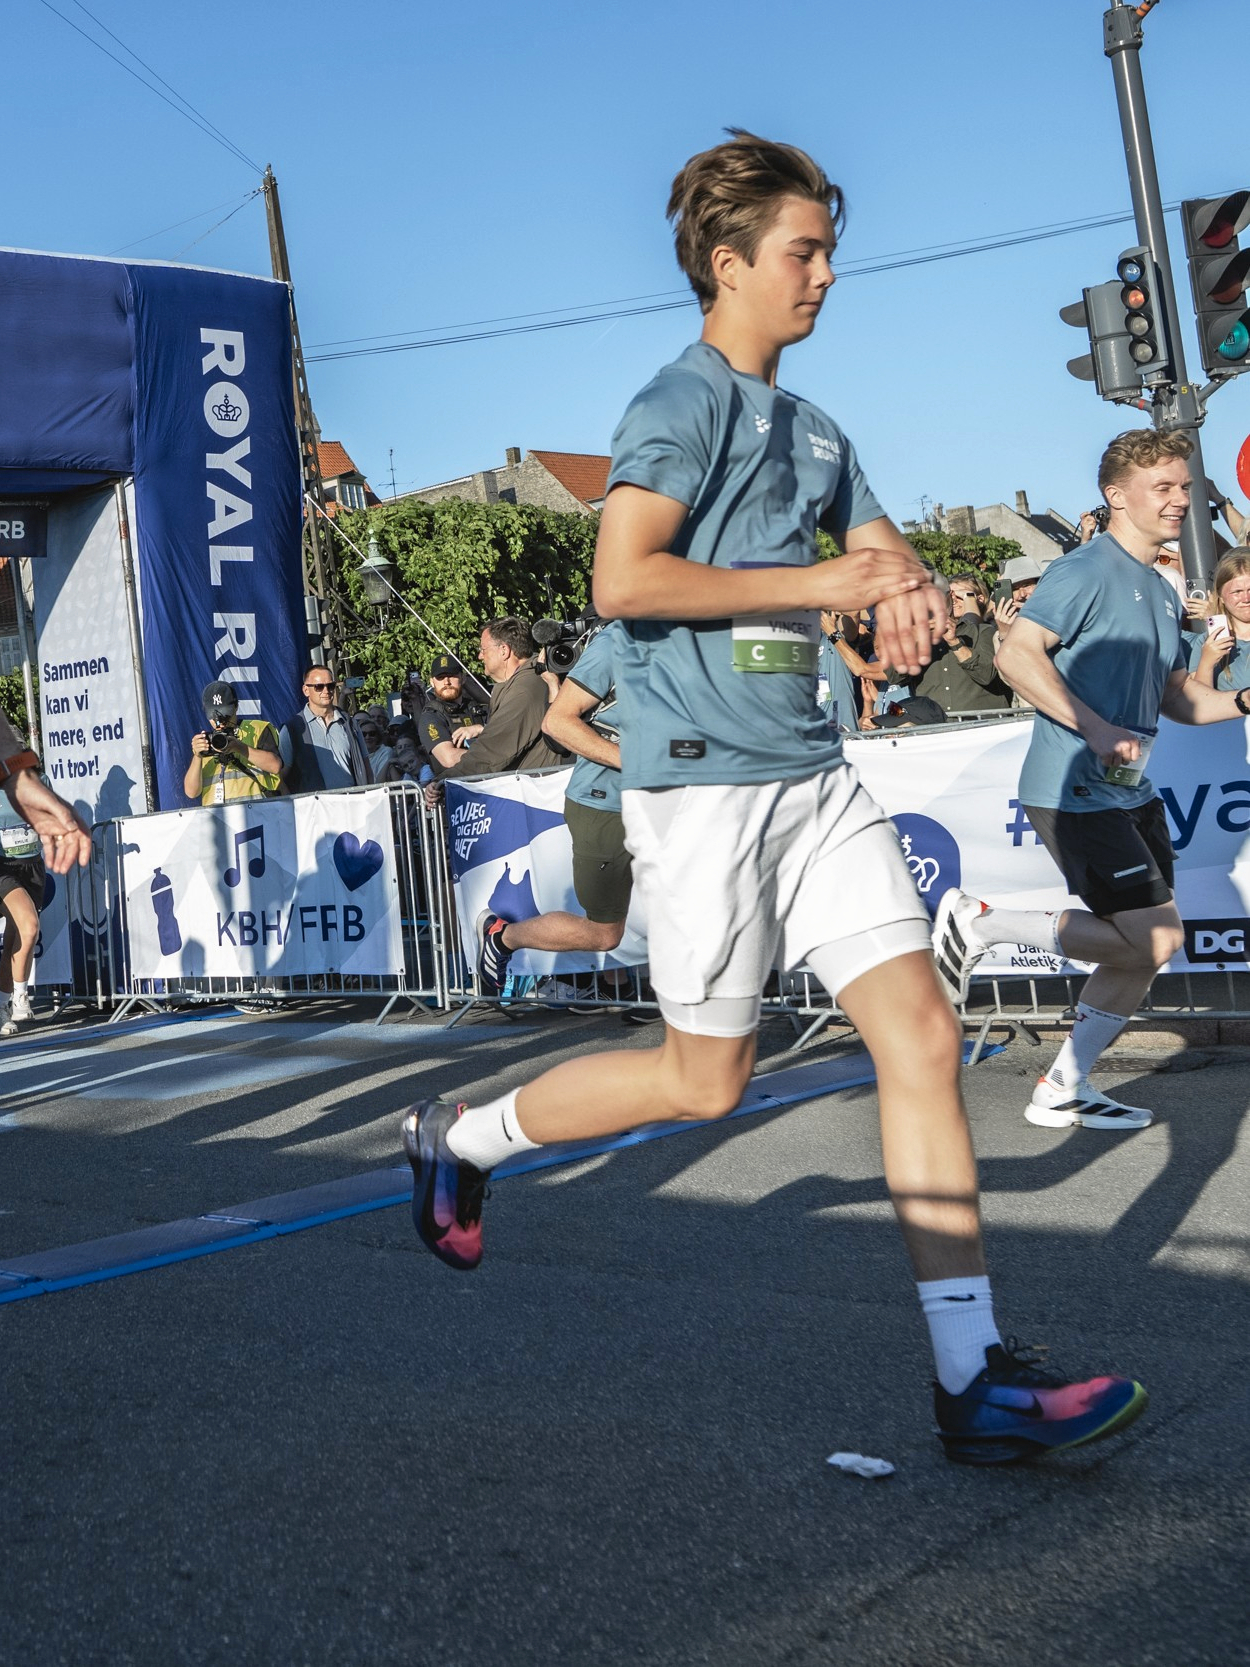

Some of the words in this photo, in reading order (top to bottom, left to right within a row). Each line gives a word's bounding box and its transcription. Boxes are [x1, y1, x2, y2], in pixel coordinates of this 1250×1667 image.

[1181, 386, 1188, 394] 5
[200, 328, 254, 586] ROYAL
[751, 644, 766, 661] C
[792, 646, 800, 662] 5
[43, 656, 109, 683] Sammen
[45, 694, 70, 715] kan
[74, 689, 89, 711] vi
[48, 728, 86, 748] mere,
[92, 717, 124, 742] end
[51, 758, 64, 780] vi
[67, 755, 100, 779] tror!
[1114, 769, 1123, 778] C
[456, 823, 472, 836] DIG
[471, 817, 492, 836] FOR
[216, 903, 366, 952] KBH/FRB
[1010, 955, 1059, 968] Atletik
